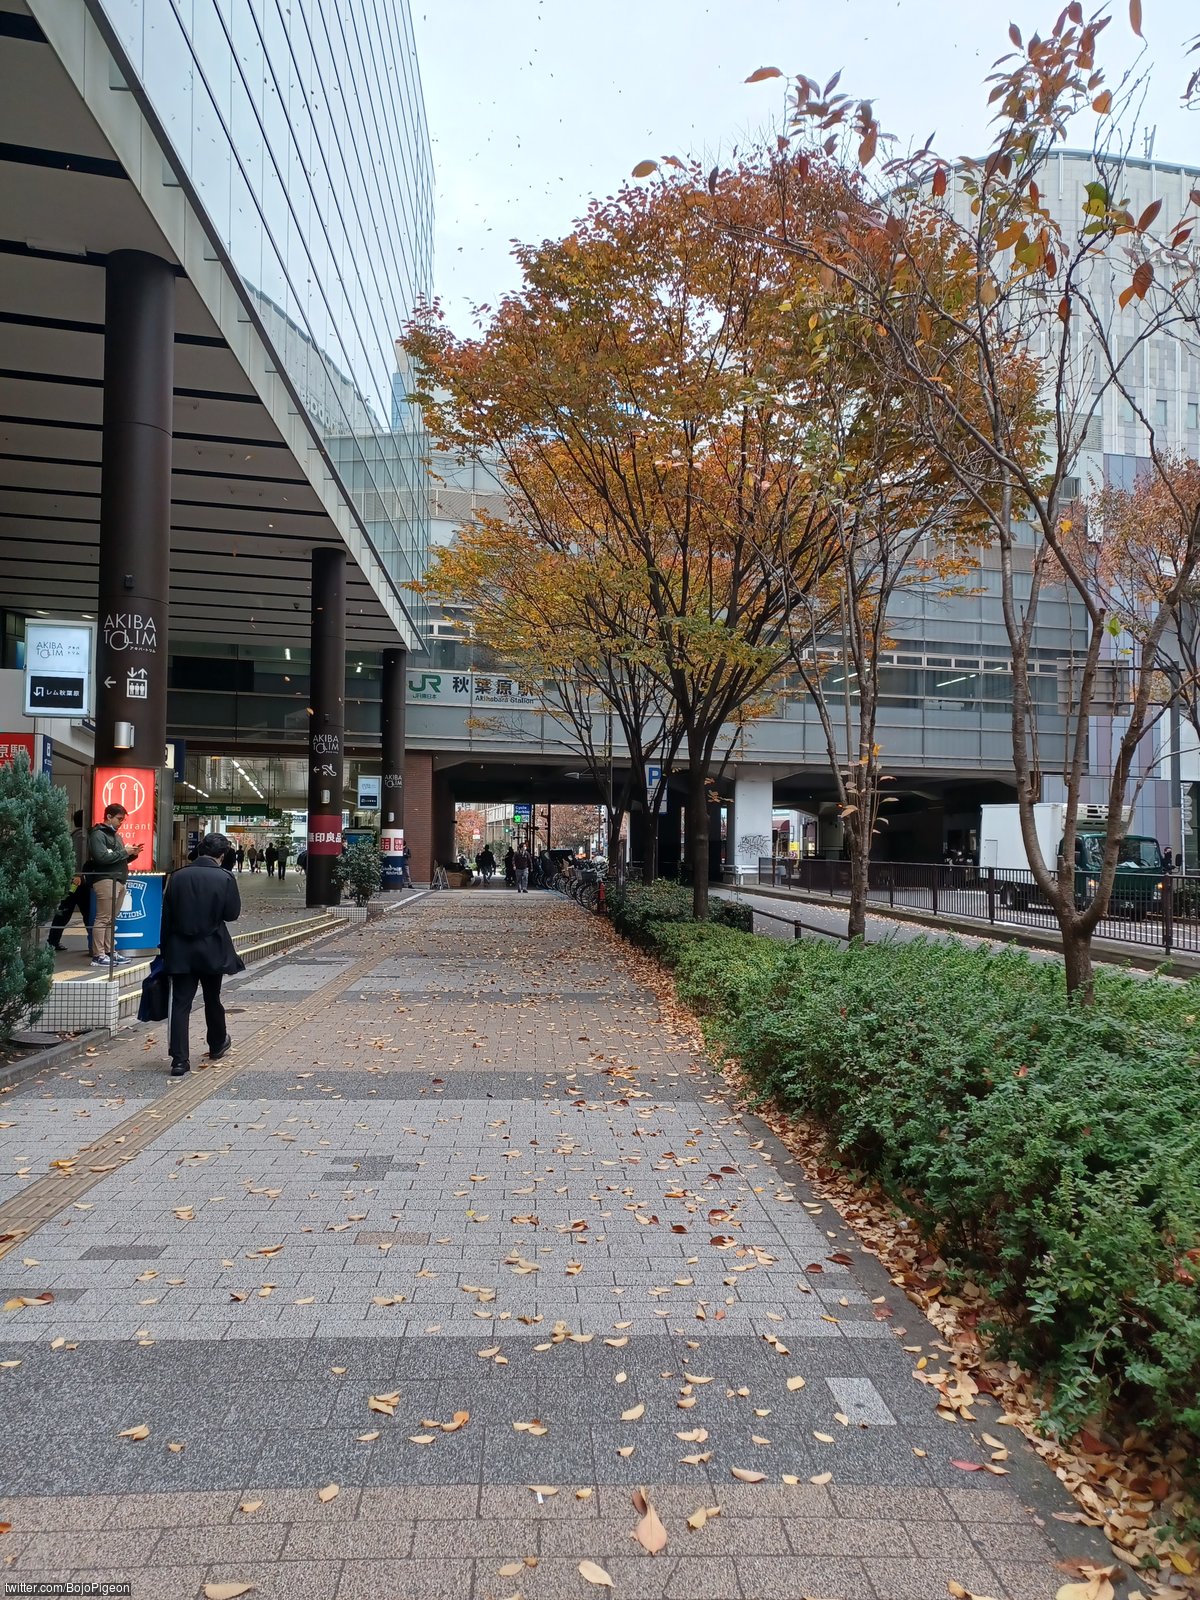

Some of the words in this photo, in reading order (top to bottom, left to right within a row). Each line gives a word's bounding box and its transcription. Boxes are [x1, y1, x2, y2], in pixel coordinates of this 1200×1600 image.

[104, 614, 157, 632] AKIBA
[104, 629, 157, 651] TOLIM
[36, 641, 64, 650] AKIBA
[408, 674, 442, 693] JR
[46, 689, 80, 697] レム秋葉原
[510, 696, 534, 704] Station
[313, 734, 340, 743] AKIBA
[648, 767, 662, 786] P
[117, 910, 143, 918] ATION
